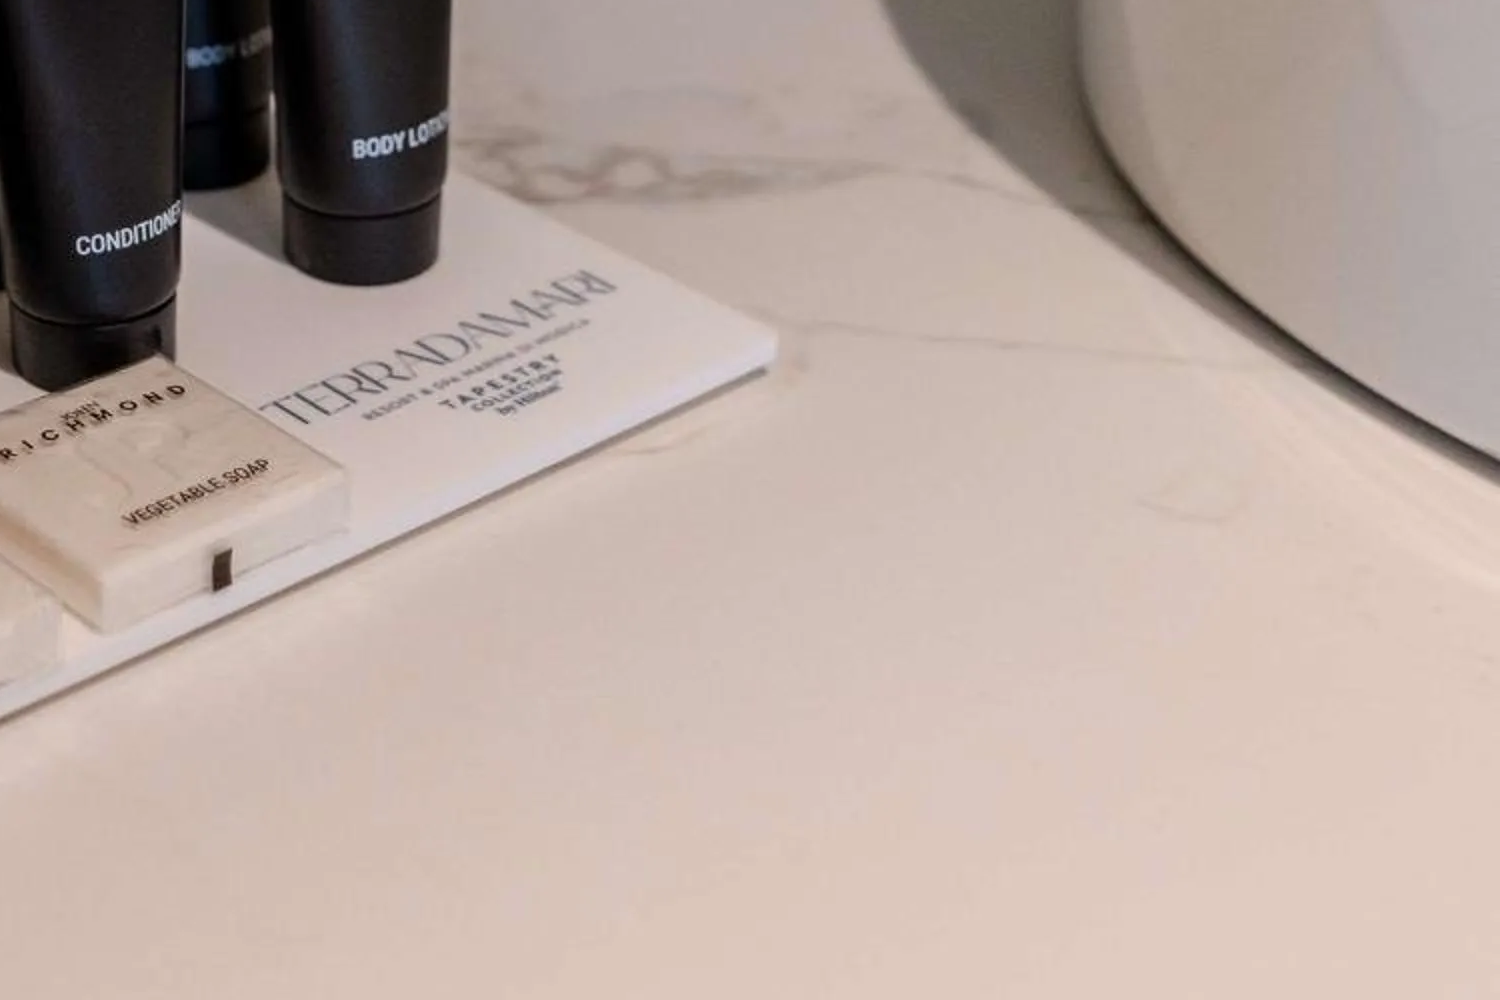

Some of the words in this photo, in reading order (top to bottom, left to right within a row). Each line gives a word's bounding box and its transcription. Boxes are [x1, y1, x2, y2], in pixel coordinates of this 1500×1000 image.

[352, 130, 406, 159] BODY
[437, 353, 560, 410] TAPESTRY
[122, 475, 226, 527] VEGETABLE
[222, 457, 270, 487] SOAP
